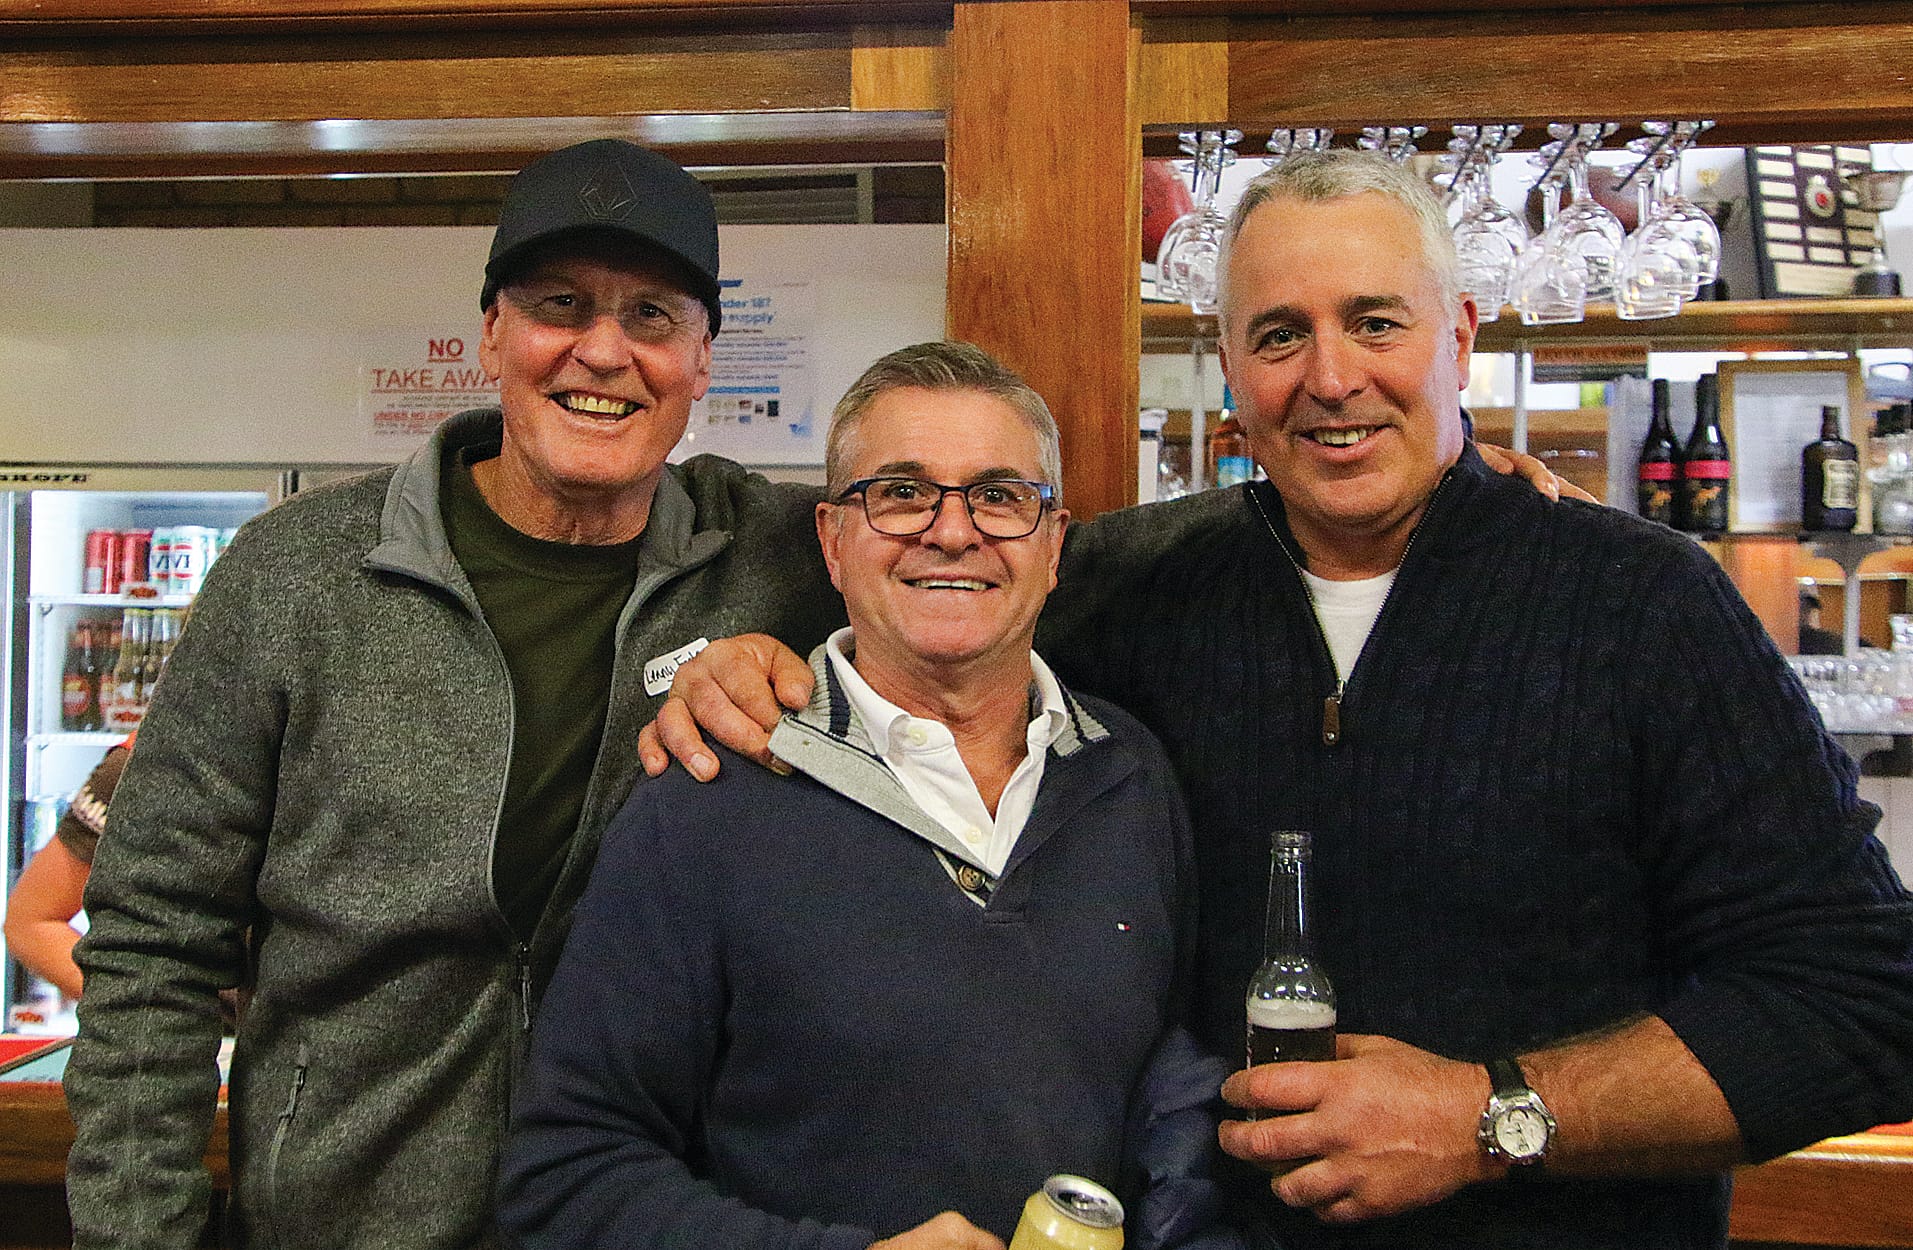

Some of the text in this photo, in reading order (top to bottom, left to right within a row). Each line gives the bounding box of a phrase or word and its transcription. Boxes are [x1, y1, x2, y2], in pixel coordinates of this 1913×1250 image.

[428, 338, 464, 356] NO
[372, 368, 500, 388] TAKE AWA
